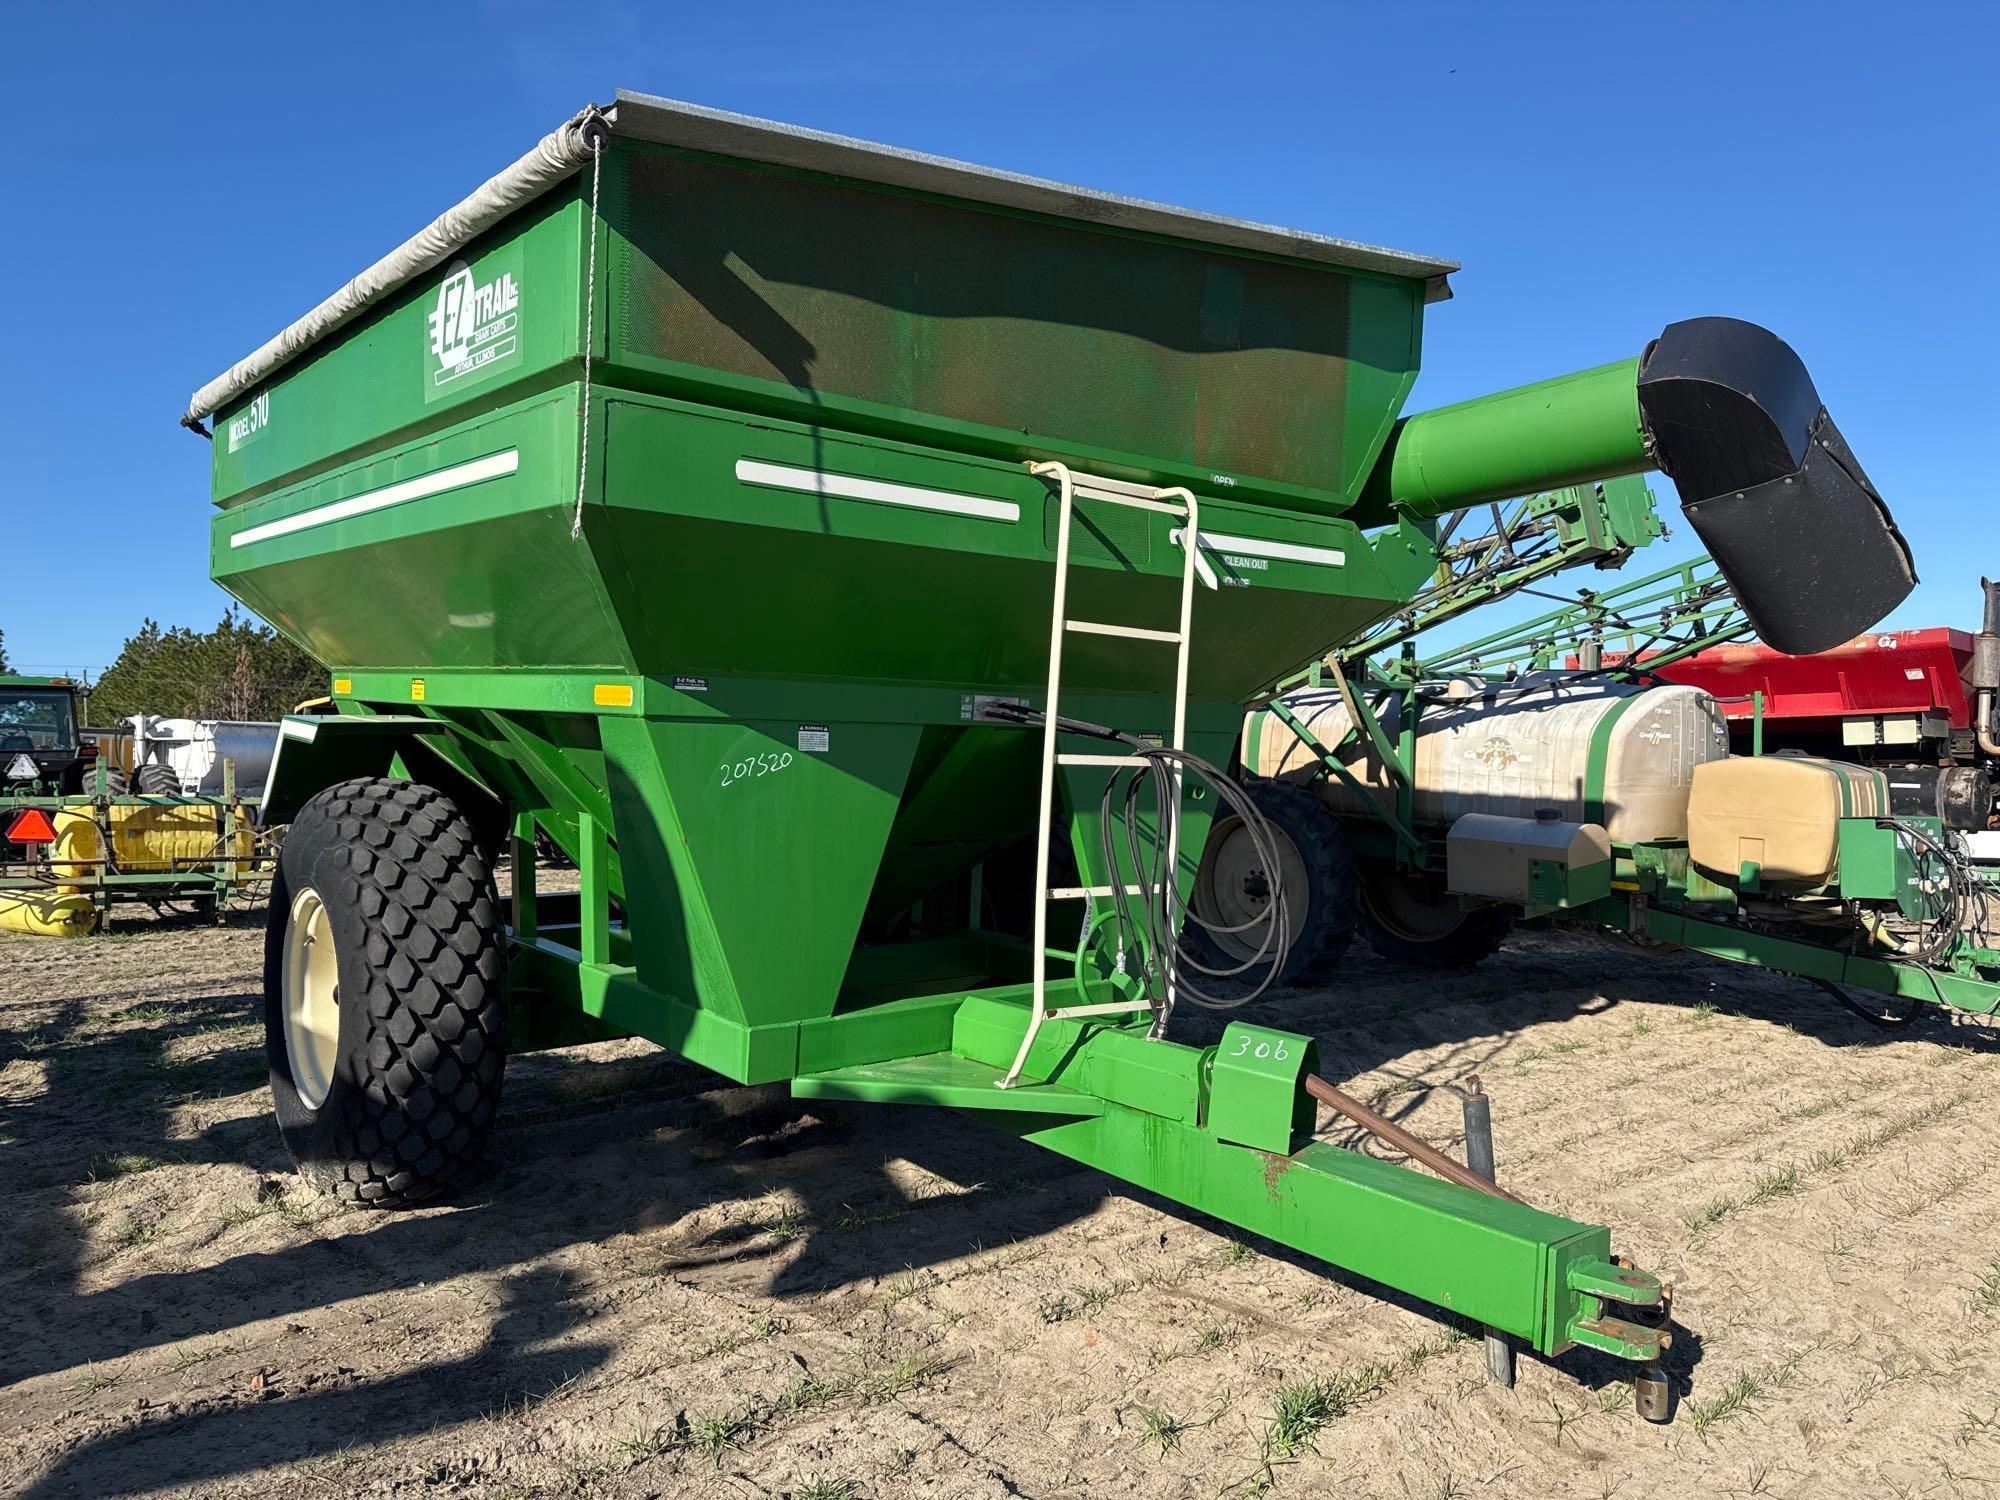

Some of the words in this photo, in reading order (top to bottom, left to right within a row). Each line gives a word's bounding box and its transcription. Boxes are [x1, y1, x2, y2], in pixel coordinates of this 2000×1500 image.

[474, 272, 518, 327] TRAIL
[490, 319, 506, 336] CARTS
[475, 348, 496, 366] ILLINOIS
[230, 415, 250, 443] MODEL
[251, 388, 269, 432] 510
[1213, 475, 1235, 487] OPEN
[1224, 555, 1250, 568] CLEAN
[1251, 559, 1268, 570] OUT
[1225, 576, 1249, 588] CLOSE
[1230, 1035, 1289, 1061] 306
